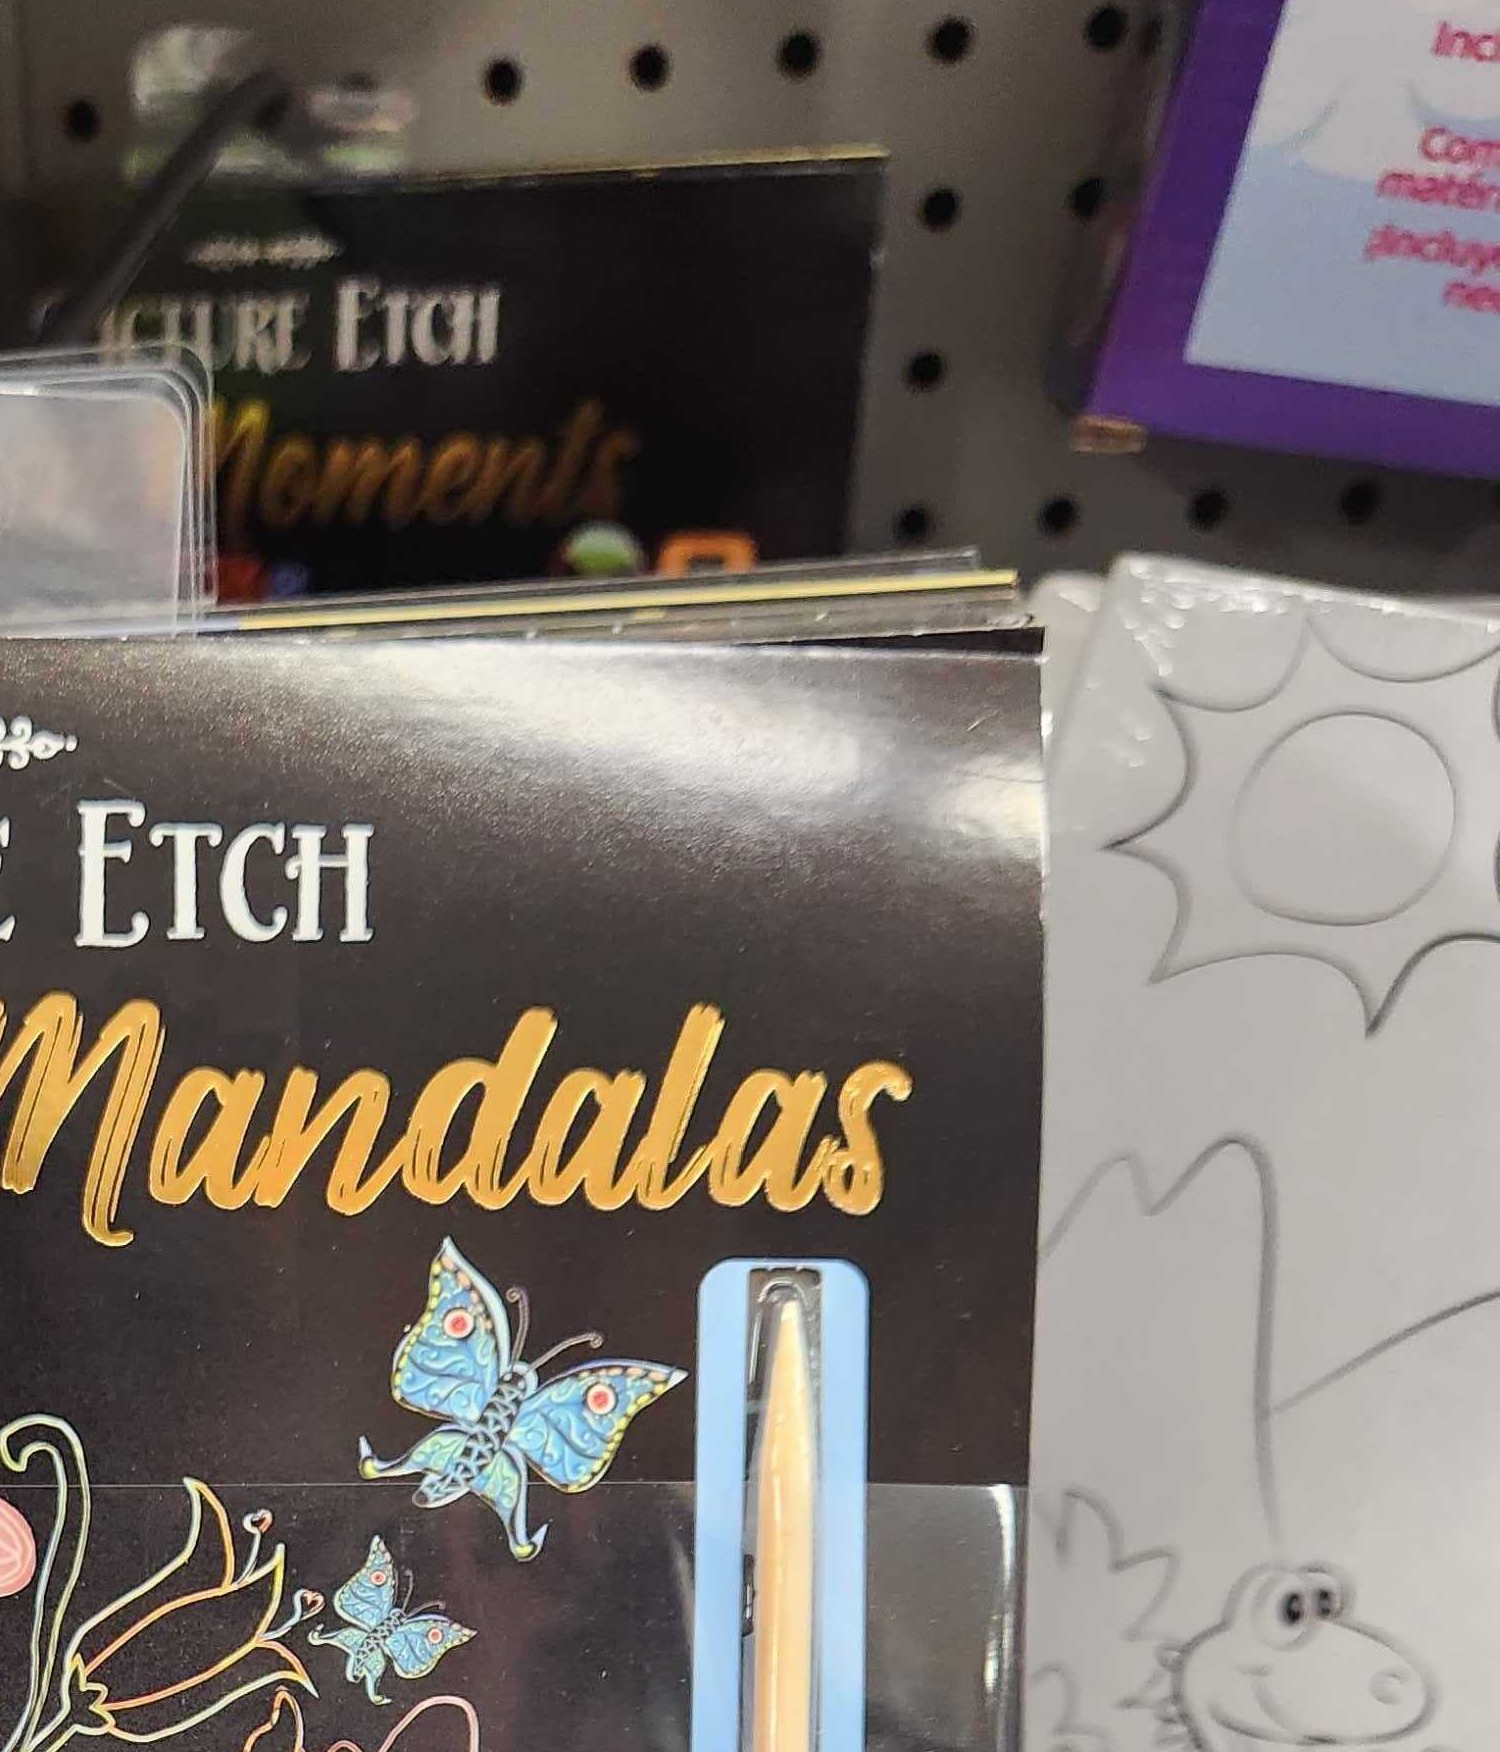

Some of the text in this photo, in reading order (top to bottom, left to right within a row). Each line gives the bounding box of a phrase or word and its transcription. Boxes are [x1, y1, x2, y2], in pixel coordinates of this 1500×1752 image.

[97, 277, 500, 375] ICTURE ETCH
[75, 798, 375, 949] ETCH
